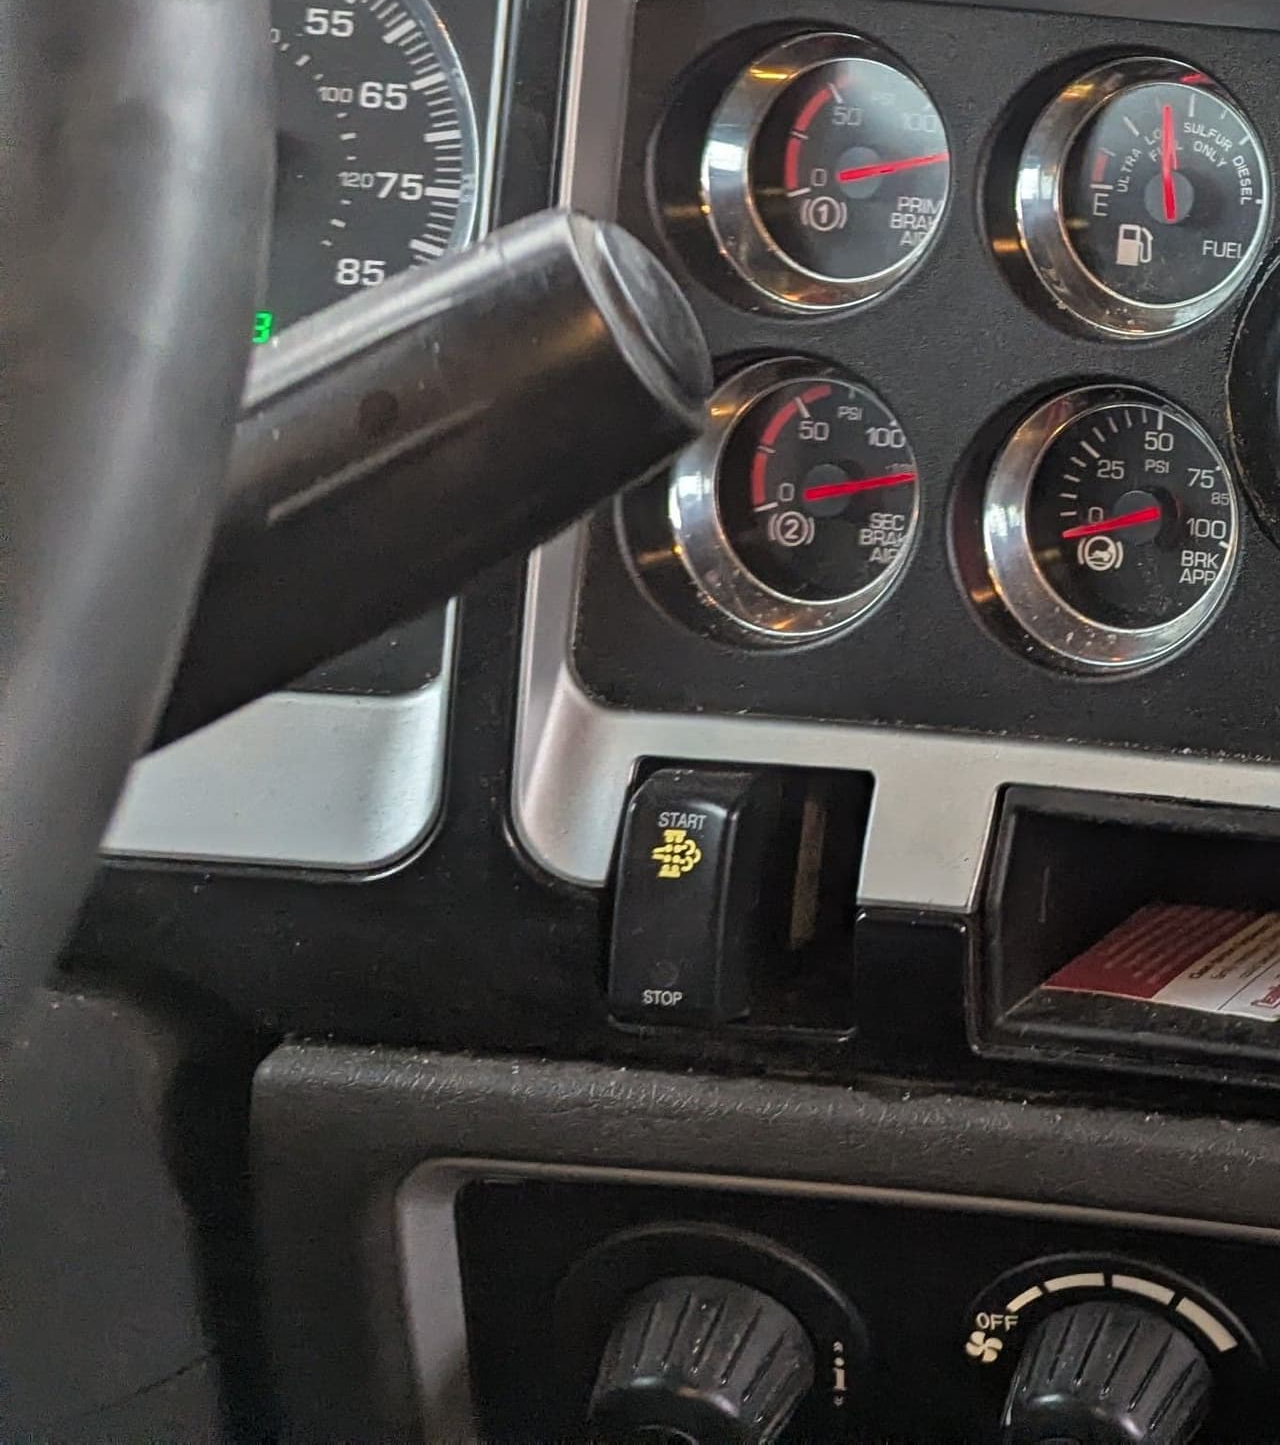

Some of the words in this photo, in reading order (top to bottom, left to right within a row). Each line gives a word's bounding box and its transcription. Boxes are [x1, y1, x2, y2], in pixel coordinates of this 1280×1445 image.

[305, 7, 355, 38] 55
[318, 85, 353, 104] 100
[359, 81, 408, 111] 65
[832, 106, 864, 127] 50
[1183, 121, 1233, 152] SULFUR
[1192, 140, 1228, 170] ONLY
[339, 170, 375, 190] 120
[811, 168, 828, 187] 0
[1115, 147, 1142, 193] ULTRA
[1231, 154, 1254, 206] DIESEL
[375, 172, 425, 202] 75
[1092, 193, 1109, 217] E
[1202, 240, 1244, 259] FUEL
[336, 259, 386, 288] 85
[837, 406, 862, 421] PSI
[799, 421, 830, 441] 50
[865, 427, 907, 448] 100
[1144, 431, 1174, 452] 50
[1096, 459, 1125, 479] 25
[1145, 459, 1170, 474] PSI
[1187, 468, 1215, 489] 75
[778, 482, 796, 502] 0
[1211, 491, 1230, 506] 85
[869, 512, 905, 531] SEC
[1186, 517, 1227, 539] 100
[1181, 550, 1219, 569] BRK
[1178, 568, 1216, 586] APP
[658, 812, 707, 830] START
[643, 989, 683, 1006] STOP
[976, 1313, 1019, 1332] OFF
